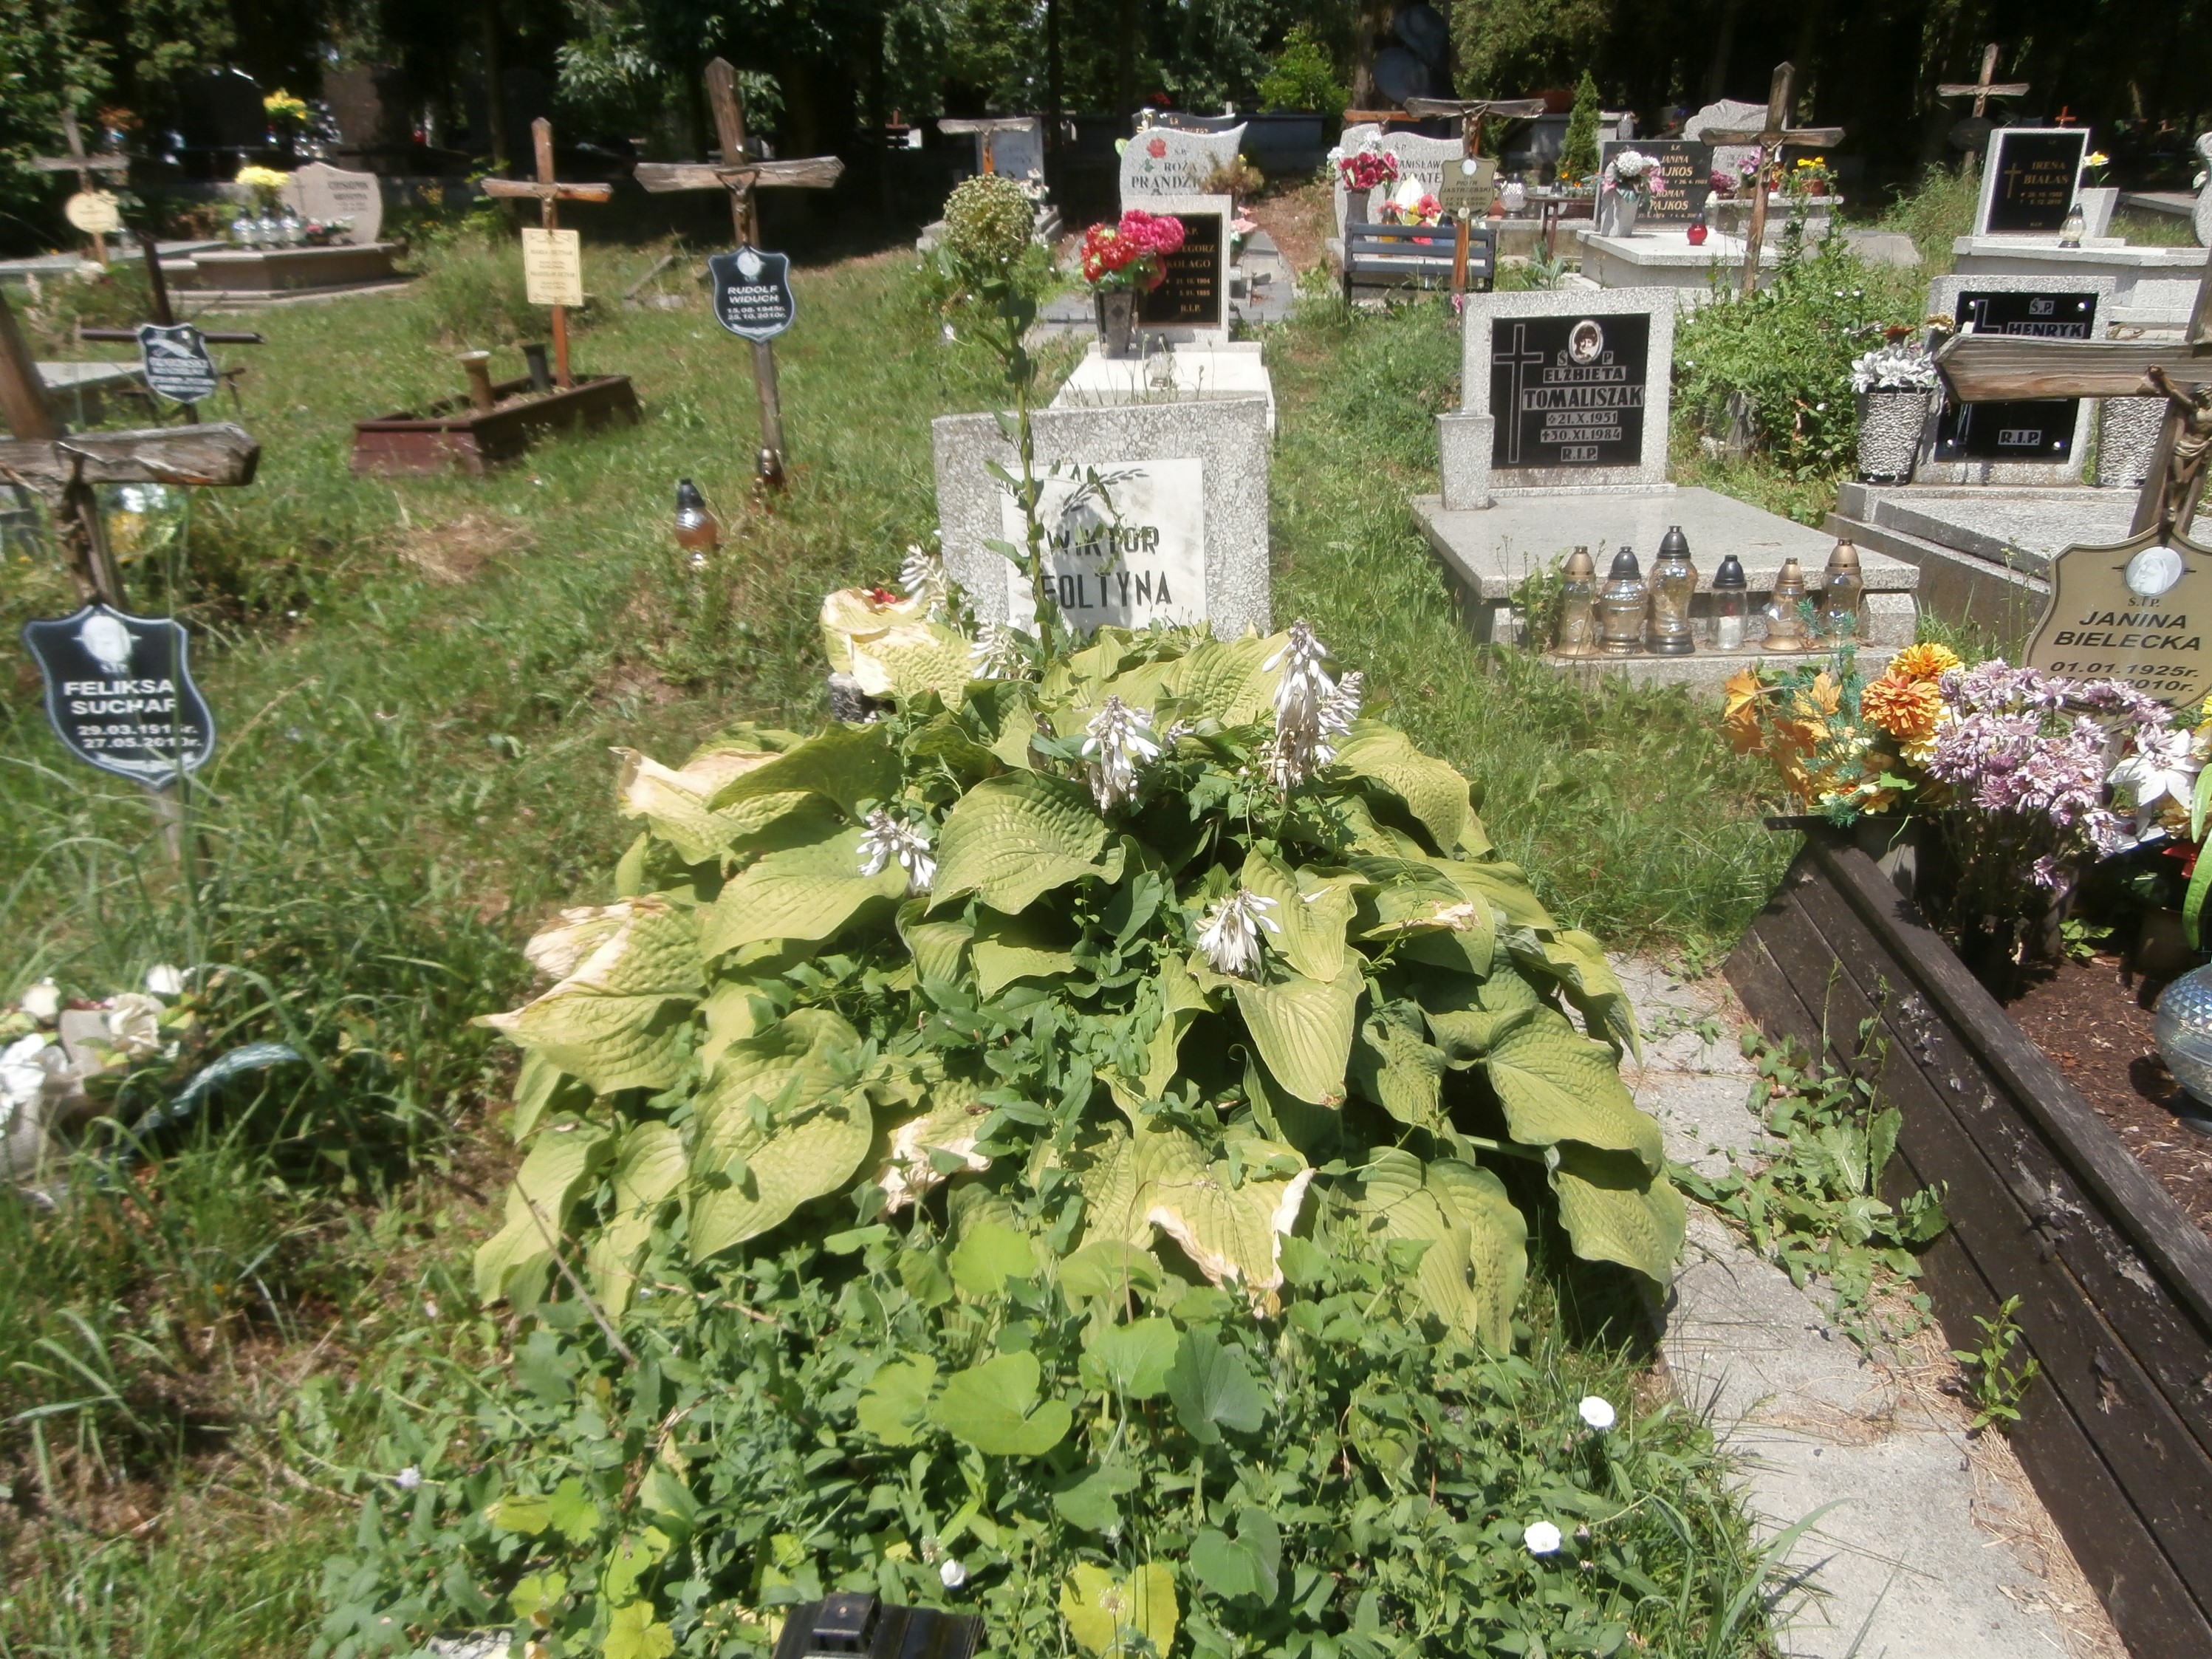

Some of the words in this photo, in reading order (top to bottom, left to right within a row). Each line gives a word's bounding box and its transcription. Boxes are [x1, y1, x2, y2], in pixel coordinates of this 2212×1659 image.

[1399, 160, 1441, 169] ANISŁAW
[1661, 155, 1689, 164] JANINA
[2032, 161, 2066, 170] IRENA
[1660, 166, 1694, 177] AJKOS
[1649, 201, 1689, 211] PAJKOS
[1182, 244, 1216, 253] EGORZ
[727, 285, 778, 295] RUDOLF
[728, 295, 780, 304] WIDUCH
[2007, 323, 2083, 337] HENRYK
[1603, 352, 1612, 363] P
[1543, 365, 1625, 382] ELŻBIETA
[1523, 386, 1644, 408] TOMALISZAK
[1999, 430, 2040, 444] R.I.P.
[1562, 446, 1597, 460] R.I.P.
[2078, 611, 2187, 629] JANINA
[2053, 631, 2201, 651] BIELECKA
[2050, 661, 2200, 678] 01.01.1925r.
[64, 679, 176, 697] FELIKSA
[77, 723, 199, 736] 29.03.191r.
